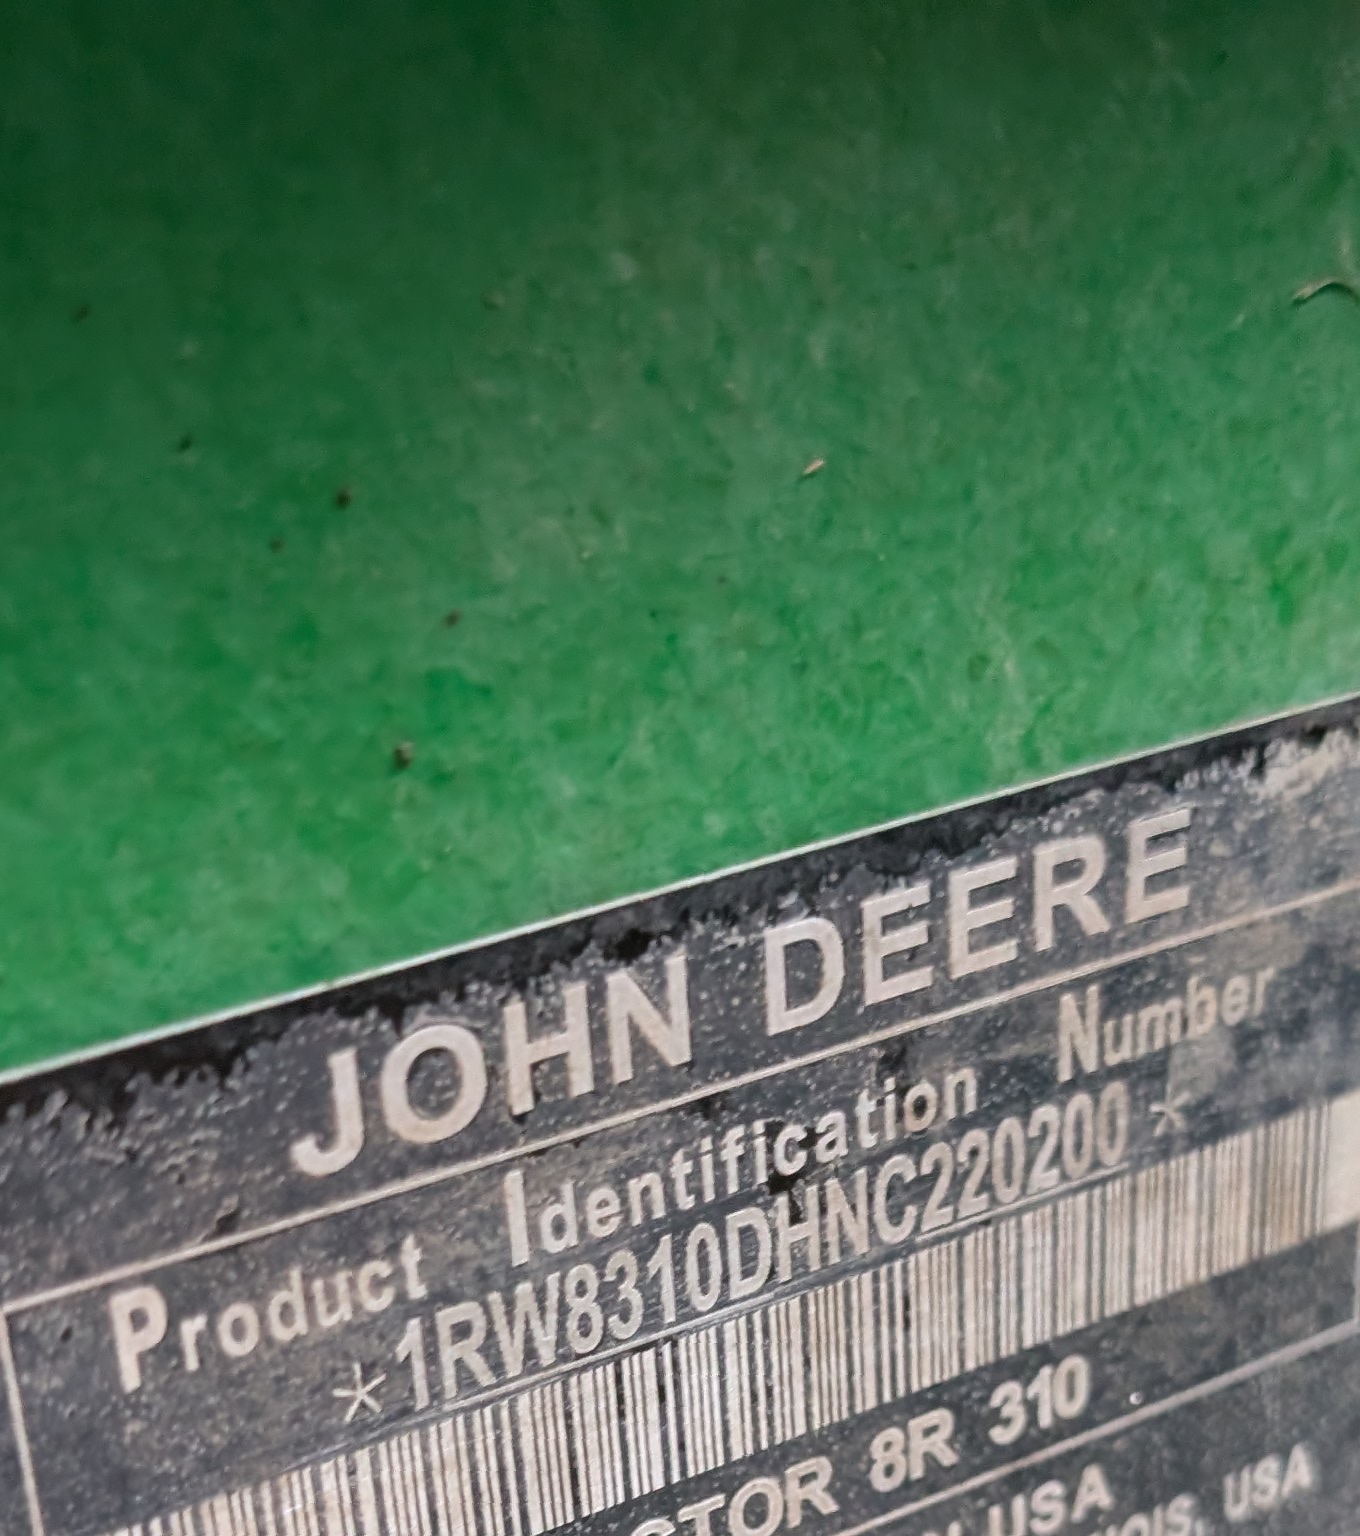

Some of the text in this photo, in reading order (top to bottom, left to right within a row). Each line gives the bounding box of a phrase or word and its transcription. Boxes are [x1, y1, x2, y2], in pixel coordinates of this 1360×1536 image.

[291, 807, 1192, 1177] JOHN DEERE
[109, 965, 1276, 1395] Product Identification Number
[868, 1407, 960, 1492] 8R
[988, 1354, 1091, 1444] 310
[1222, 1441, 1318, 1524] USA
